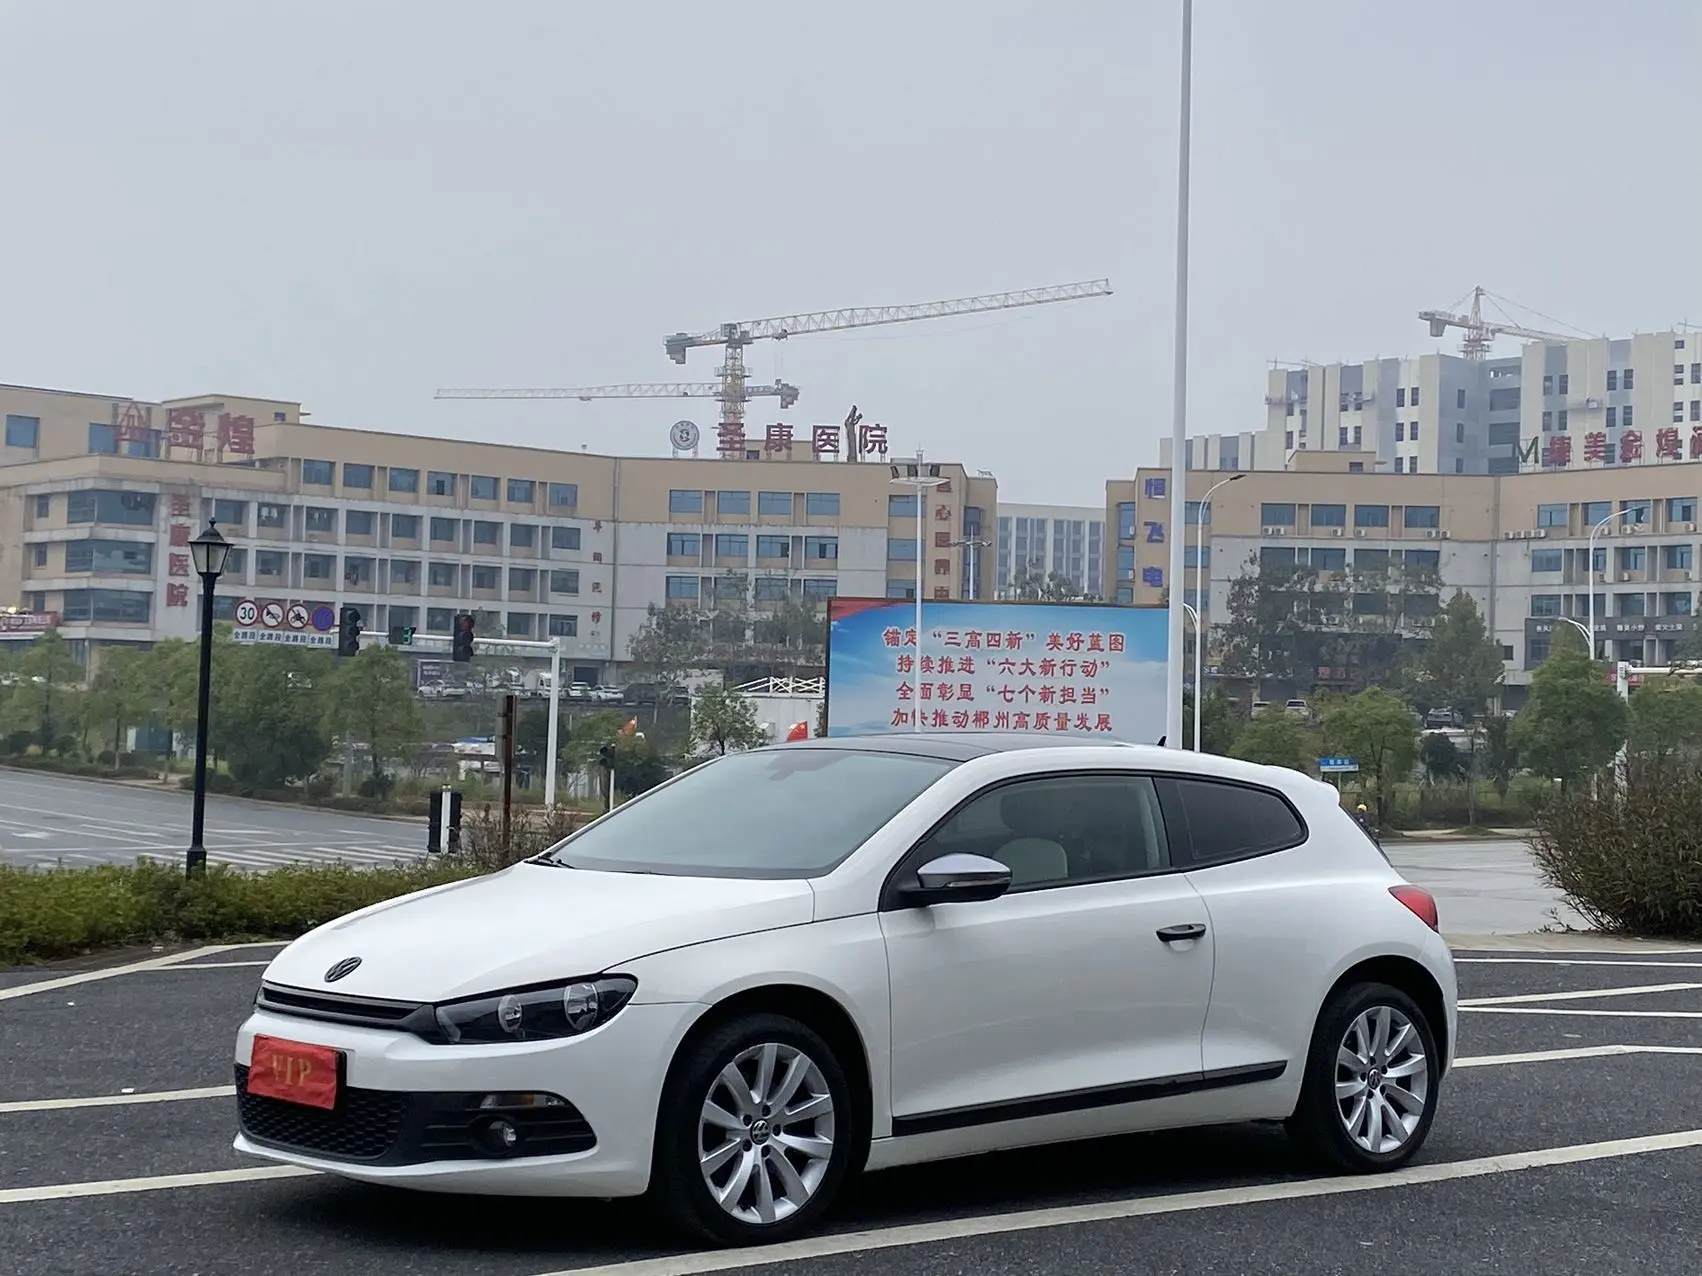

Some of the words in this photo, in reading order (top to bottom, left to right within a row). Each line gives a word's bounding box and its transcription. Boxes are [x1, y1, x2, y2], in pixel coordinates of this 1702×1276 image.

[716, 423, 888, 454] 圣康医院
[239, 606, 256, 620] 30
[259, 632, 282, 642] 全路段
[271, 1053, 312, 1087] VIP
